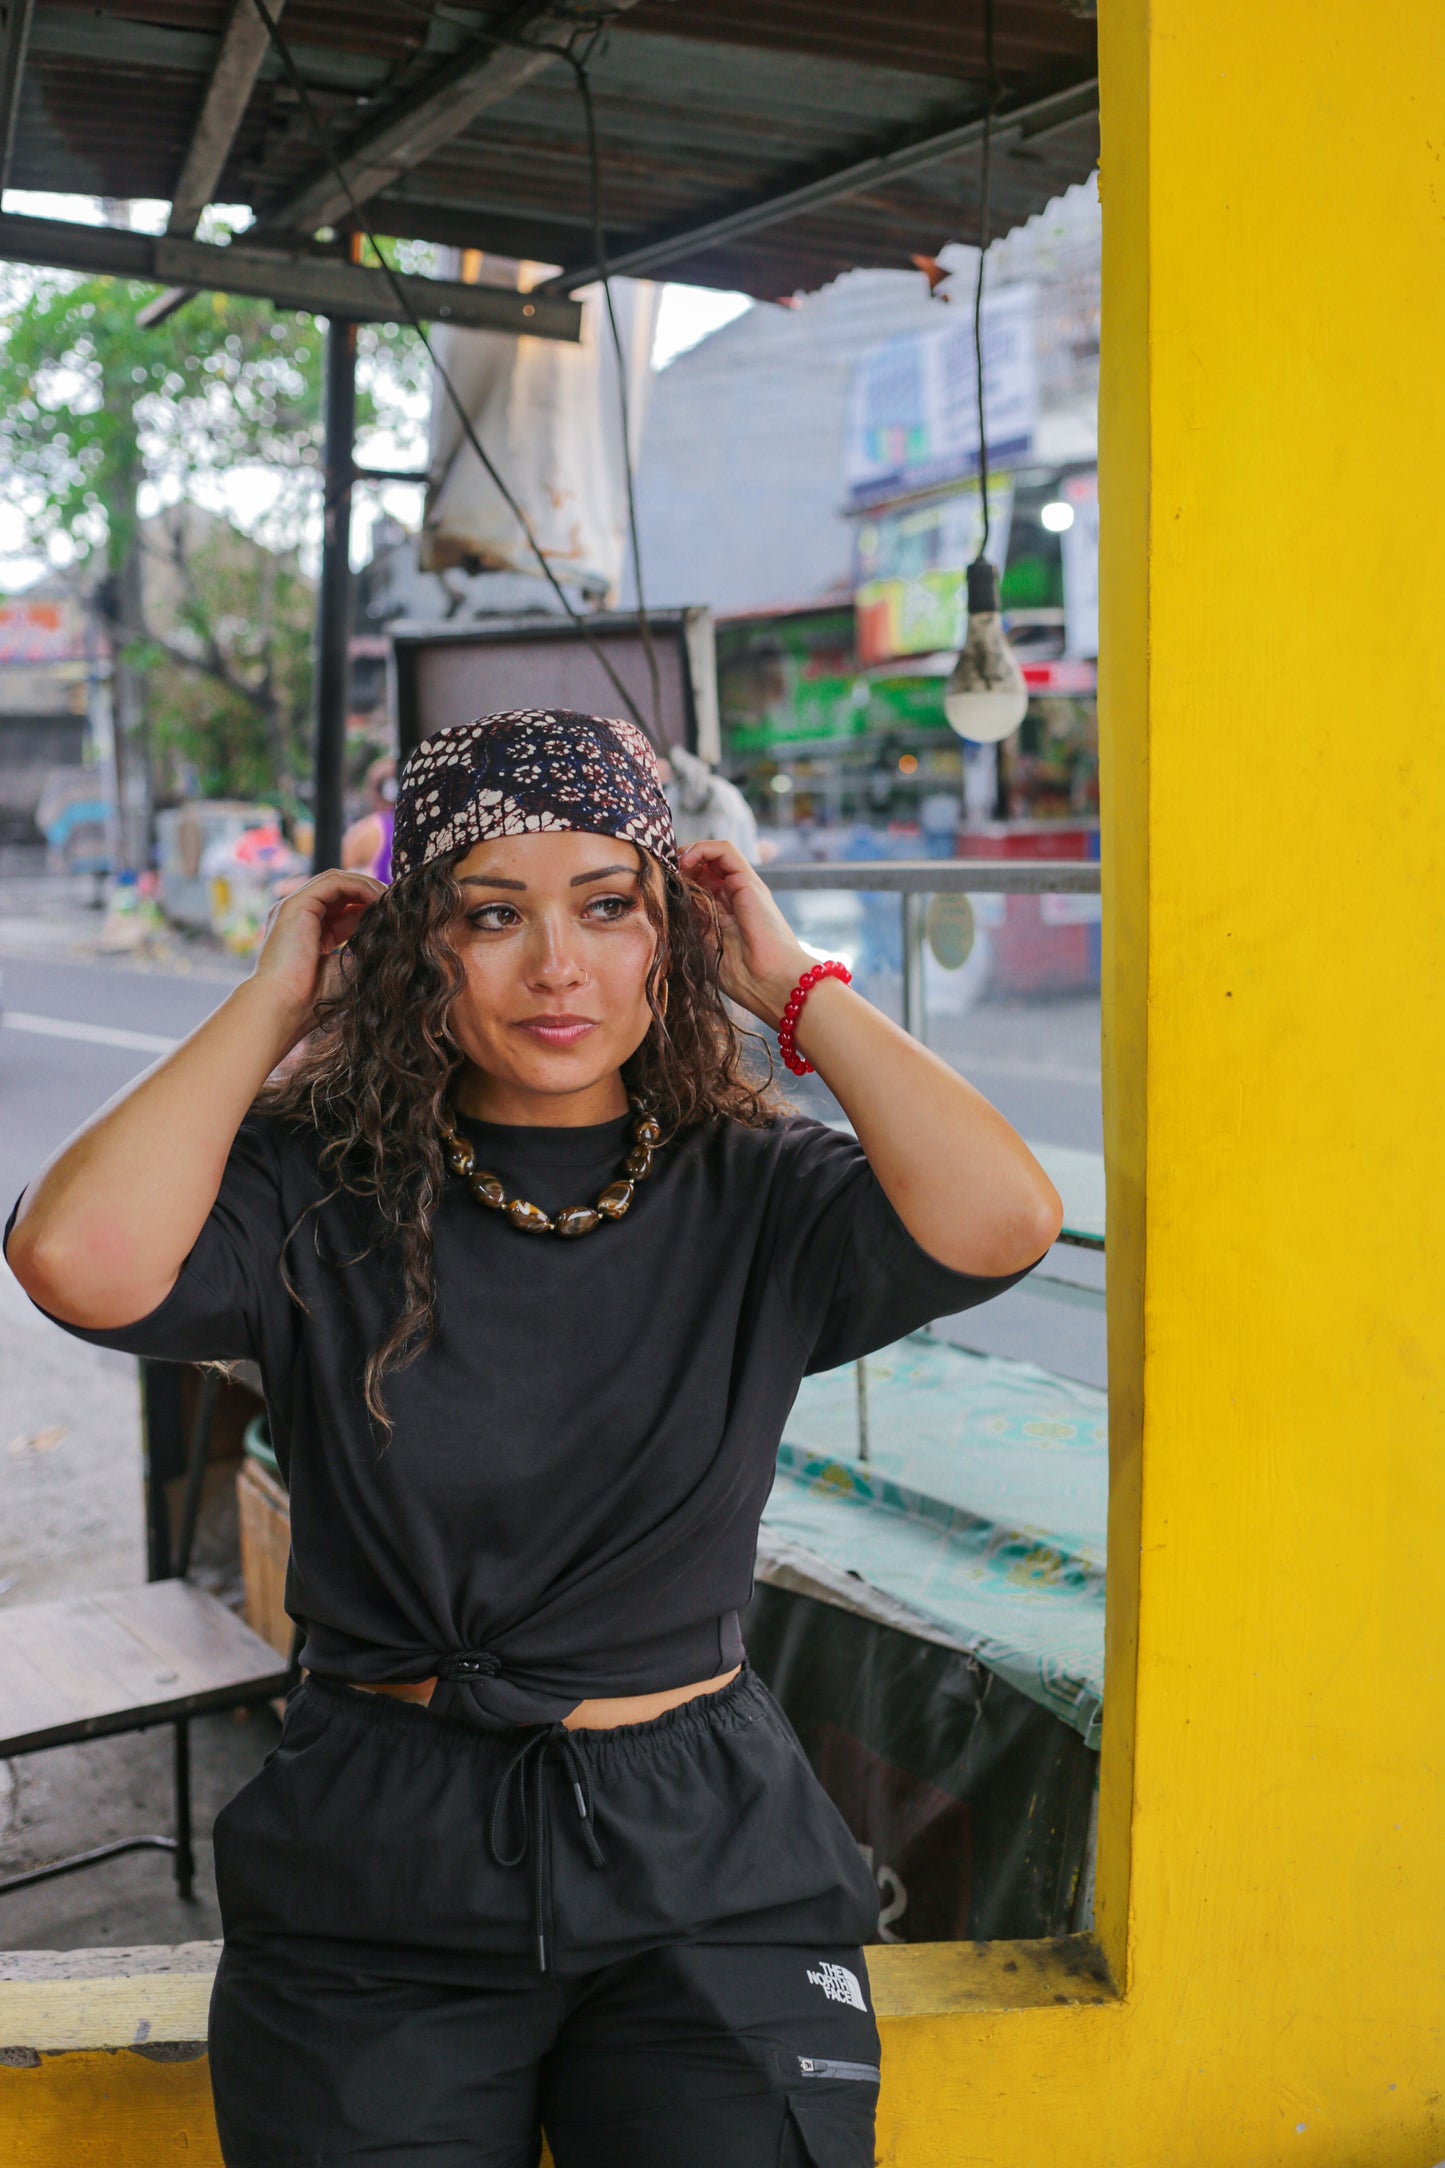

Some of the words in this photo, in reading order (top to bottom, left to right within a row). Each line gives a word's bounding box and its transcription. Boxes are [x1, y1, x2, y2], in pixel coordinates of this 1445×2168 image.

[819, 1961, 844, 1977] THE
[806, 1969, 848, 1991] NORTH
[823, 1985, 853, 2004] FACE
